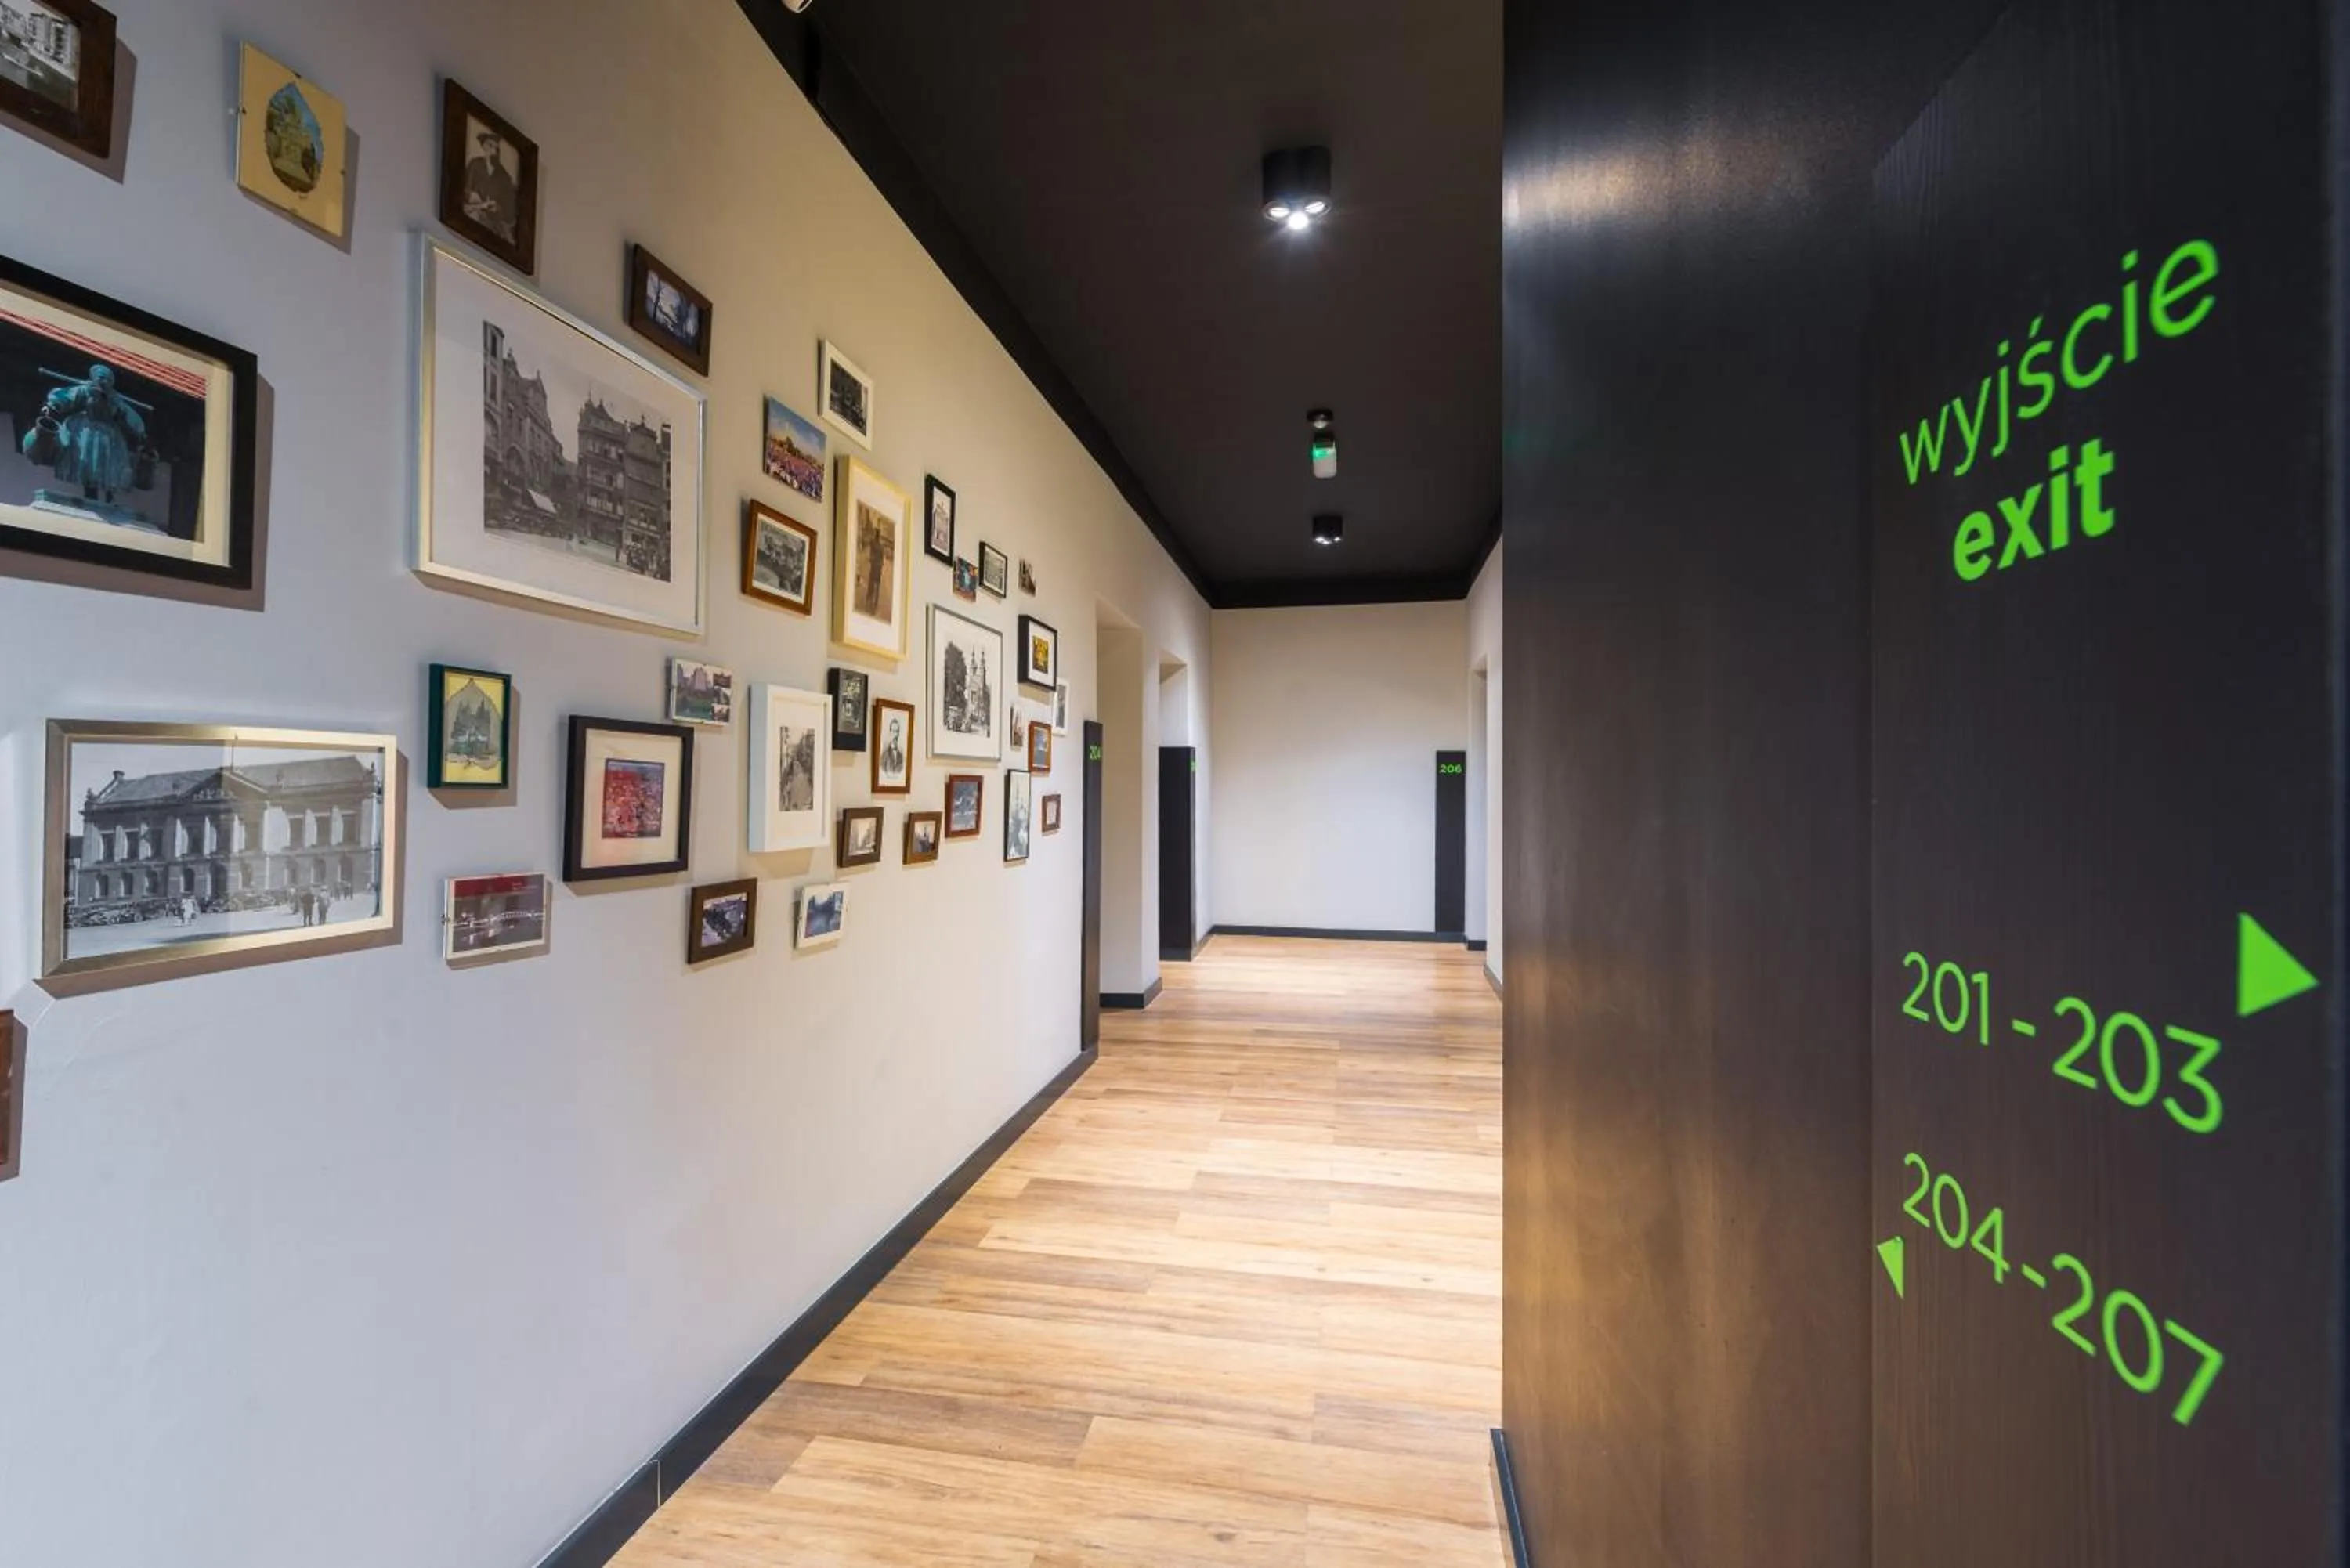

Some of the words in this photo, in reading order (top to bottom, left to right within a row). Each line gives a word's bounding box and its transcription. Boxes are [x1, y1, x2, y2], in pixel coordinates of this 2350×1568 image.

[1899, 240, 2218, 485] wyjście
[1952, 437, 2115, 582] exit
[1440, 764, 1462, 774] 206
